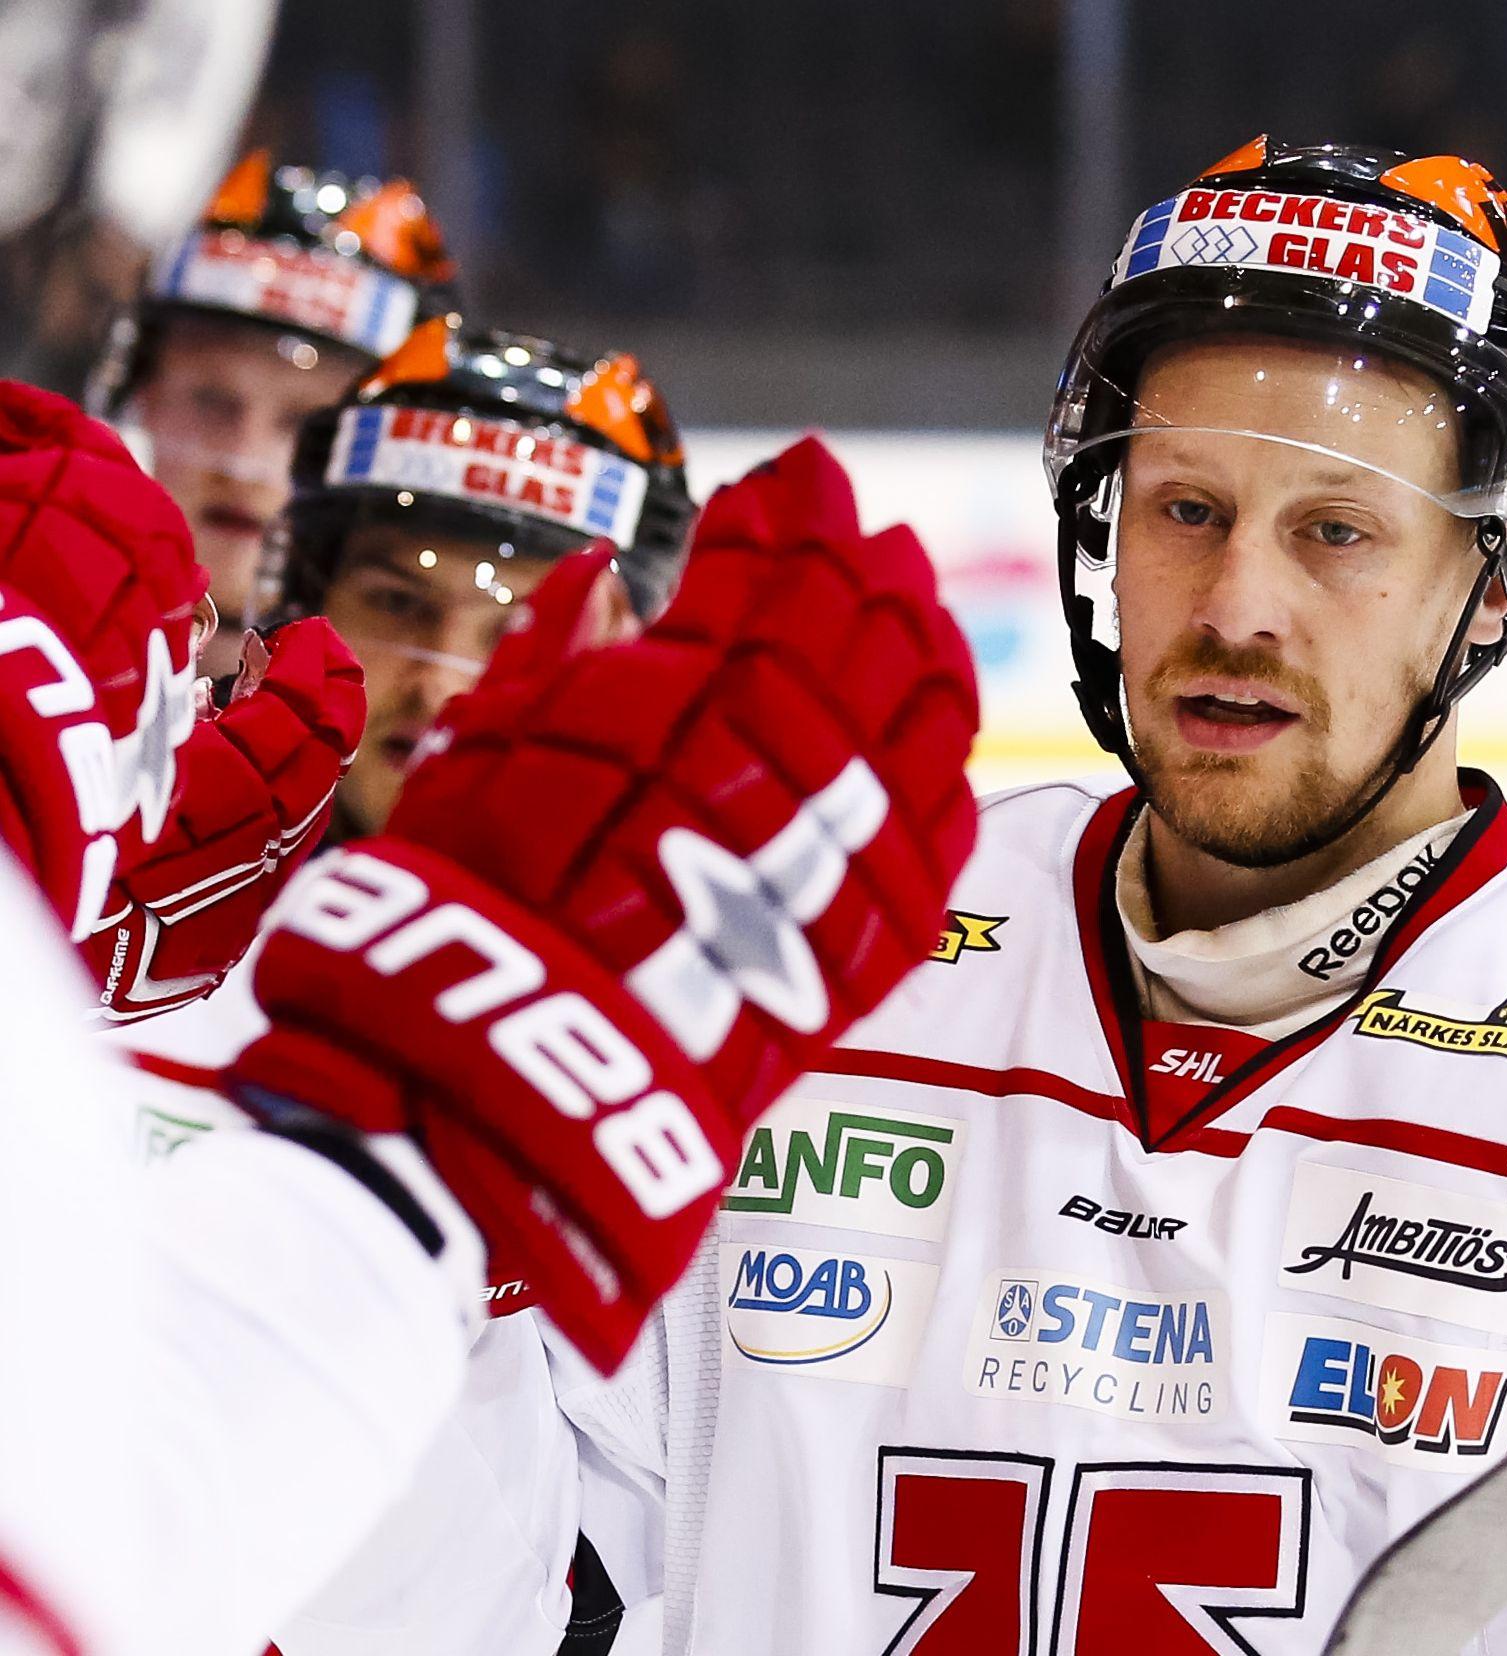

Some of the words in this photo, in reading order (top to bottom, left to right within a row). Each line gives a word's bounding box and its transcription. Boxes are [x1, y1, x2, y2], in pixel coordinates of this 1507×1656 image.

[1177, 190, 1427, 249] BECKERS
[1266, 232, 1418, 293] GLAS
[1298, 843, 1444, 981] Reebok
[1369, 1012, 1477, 1048] NÄRKES
[1149, 1048, 1229, 1084] SHL
[720, 1111, 954, 1214] ANFO
[728, 1249, 873, 1321] MOAB
[1037, 1283, 1214, 1366] STENA
[978, 1357, 1214, 1415] RECYCLING
